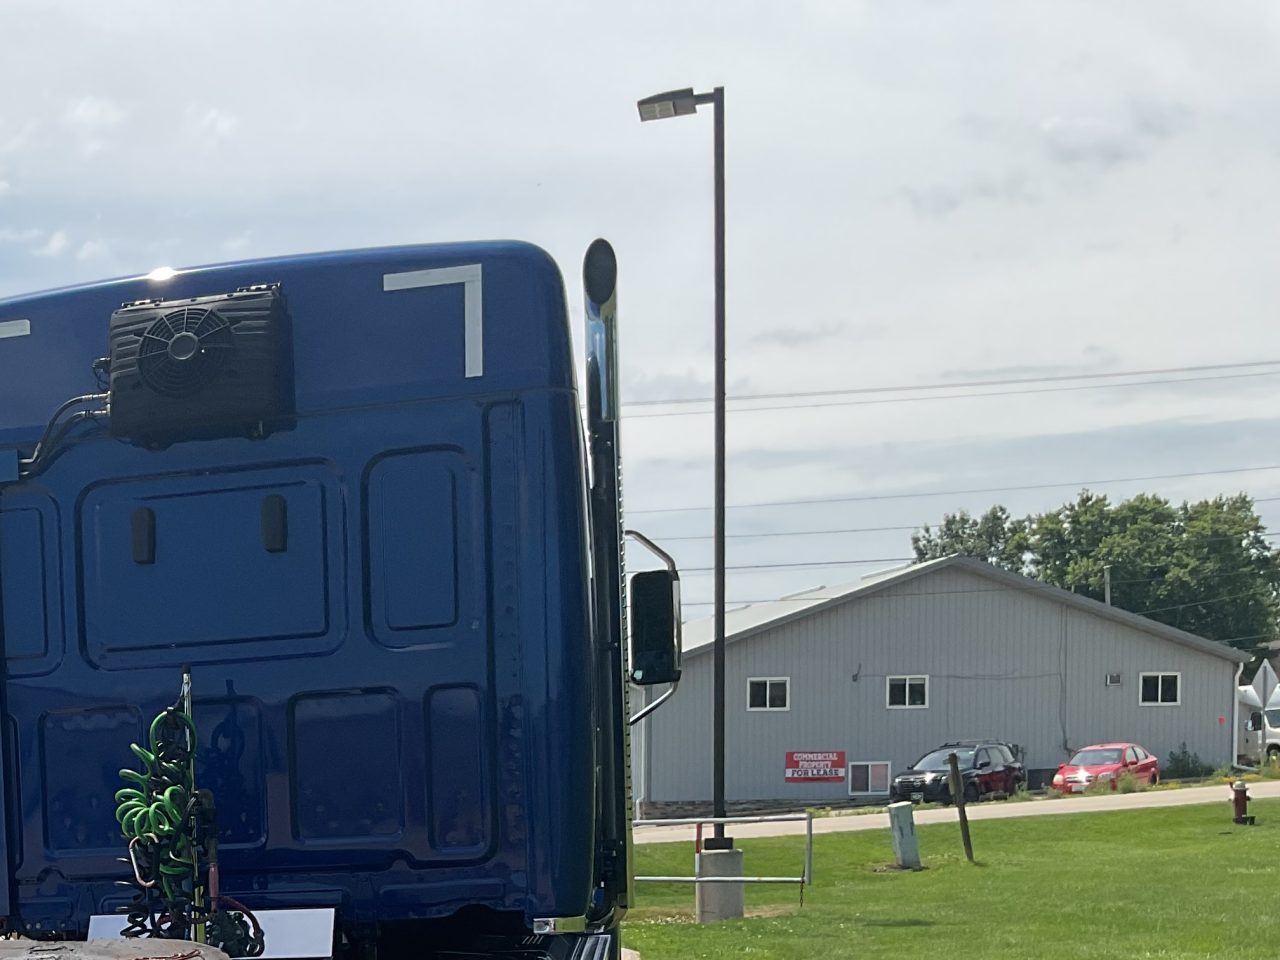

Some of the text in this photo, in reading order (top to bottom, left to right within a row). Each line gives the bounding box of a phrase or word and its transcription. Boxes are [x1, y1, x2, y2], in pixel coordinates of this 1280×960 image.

[793, 752, 838, 761] COMMERCIAL
[799, 760, 832, 769] PROPERTY
[791, 769, 839, 777] FOR LEASE
